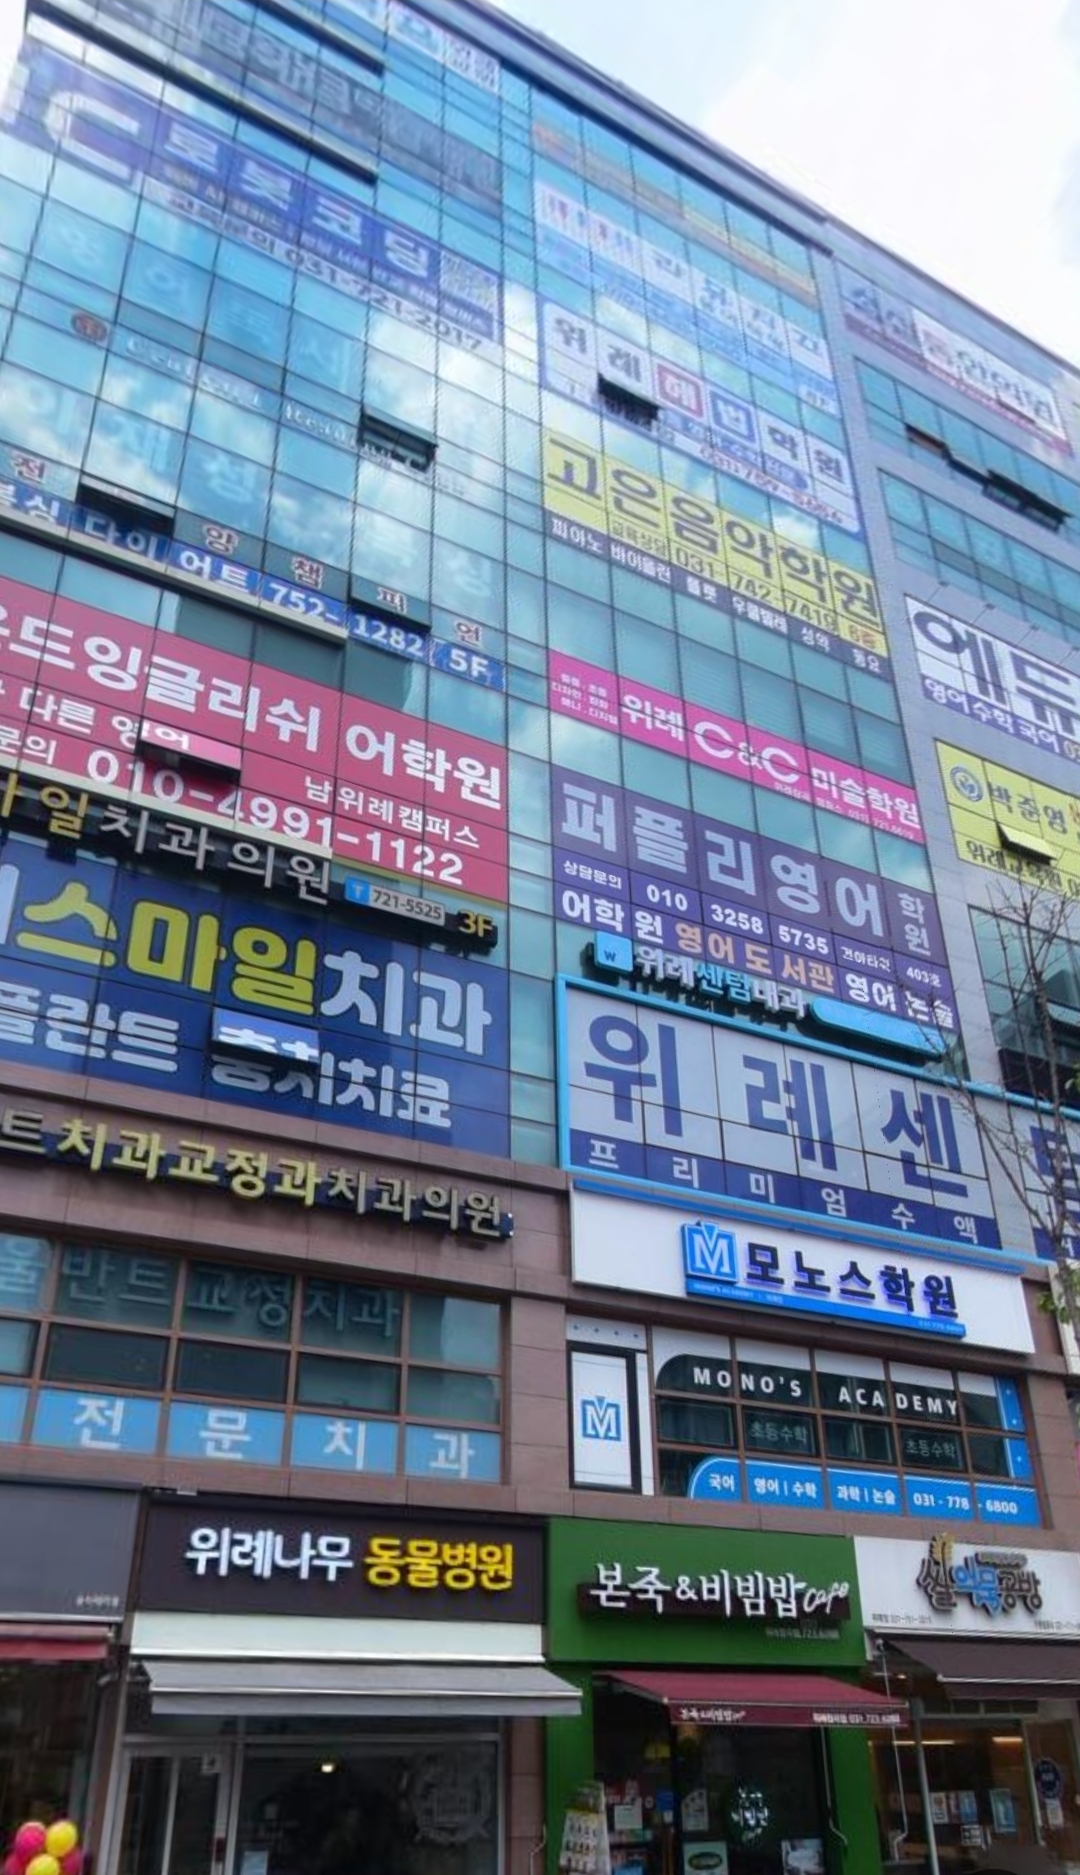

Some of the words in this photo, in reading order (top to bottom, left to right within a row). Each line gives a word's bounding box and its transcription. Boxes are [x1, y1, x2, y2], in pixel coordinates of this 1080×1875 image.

[547, 435, 881, 628] 고은음악학원
[551, 515, 604, 555] 피아노
[611, 542, 672, 585] 바이올린
[84, 513, 250, 594] 다이어트
[450, 647, 490, 679] 5F
[20, 686, 95, 735] 다른
[345, 723, 503, 810] 어학원
[694, 720, 800, 784] C&C
[811, 766, 922, 830] 미술학원
[86, 747, 464, 886] 010-4991-1122
[560, 781, 884, 938] 퍼플리영어
[373, 887, 443, 920] 721-5525
[458, 909, 495, 940] 3F
[563, 858, 624, 891] 상담문의
[646, 883, 689, 912] 010
[711, 903, 764, 935] 3258
[778, 925, 830, 956] 5735
[746, 1240, 959, 1319] 모노스학원
[692, 1364, 804, 1399] MONO'S
[838, 1386, 960, 1418] ACADEMY
[709, 1473, 735, 1493] 국어
[184, 1526, 355, 1583] 위례나무
[363, 1534, 514, 1592] 동물병원
